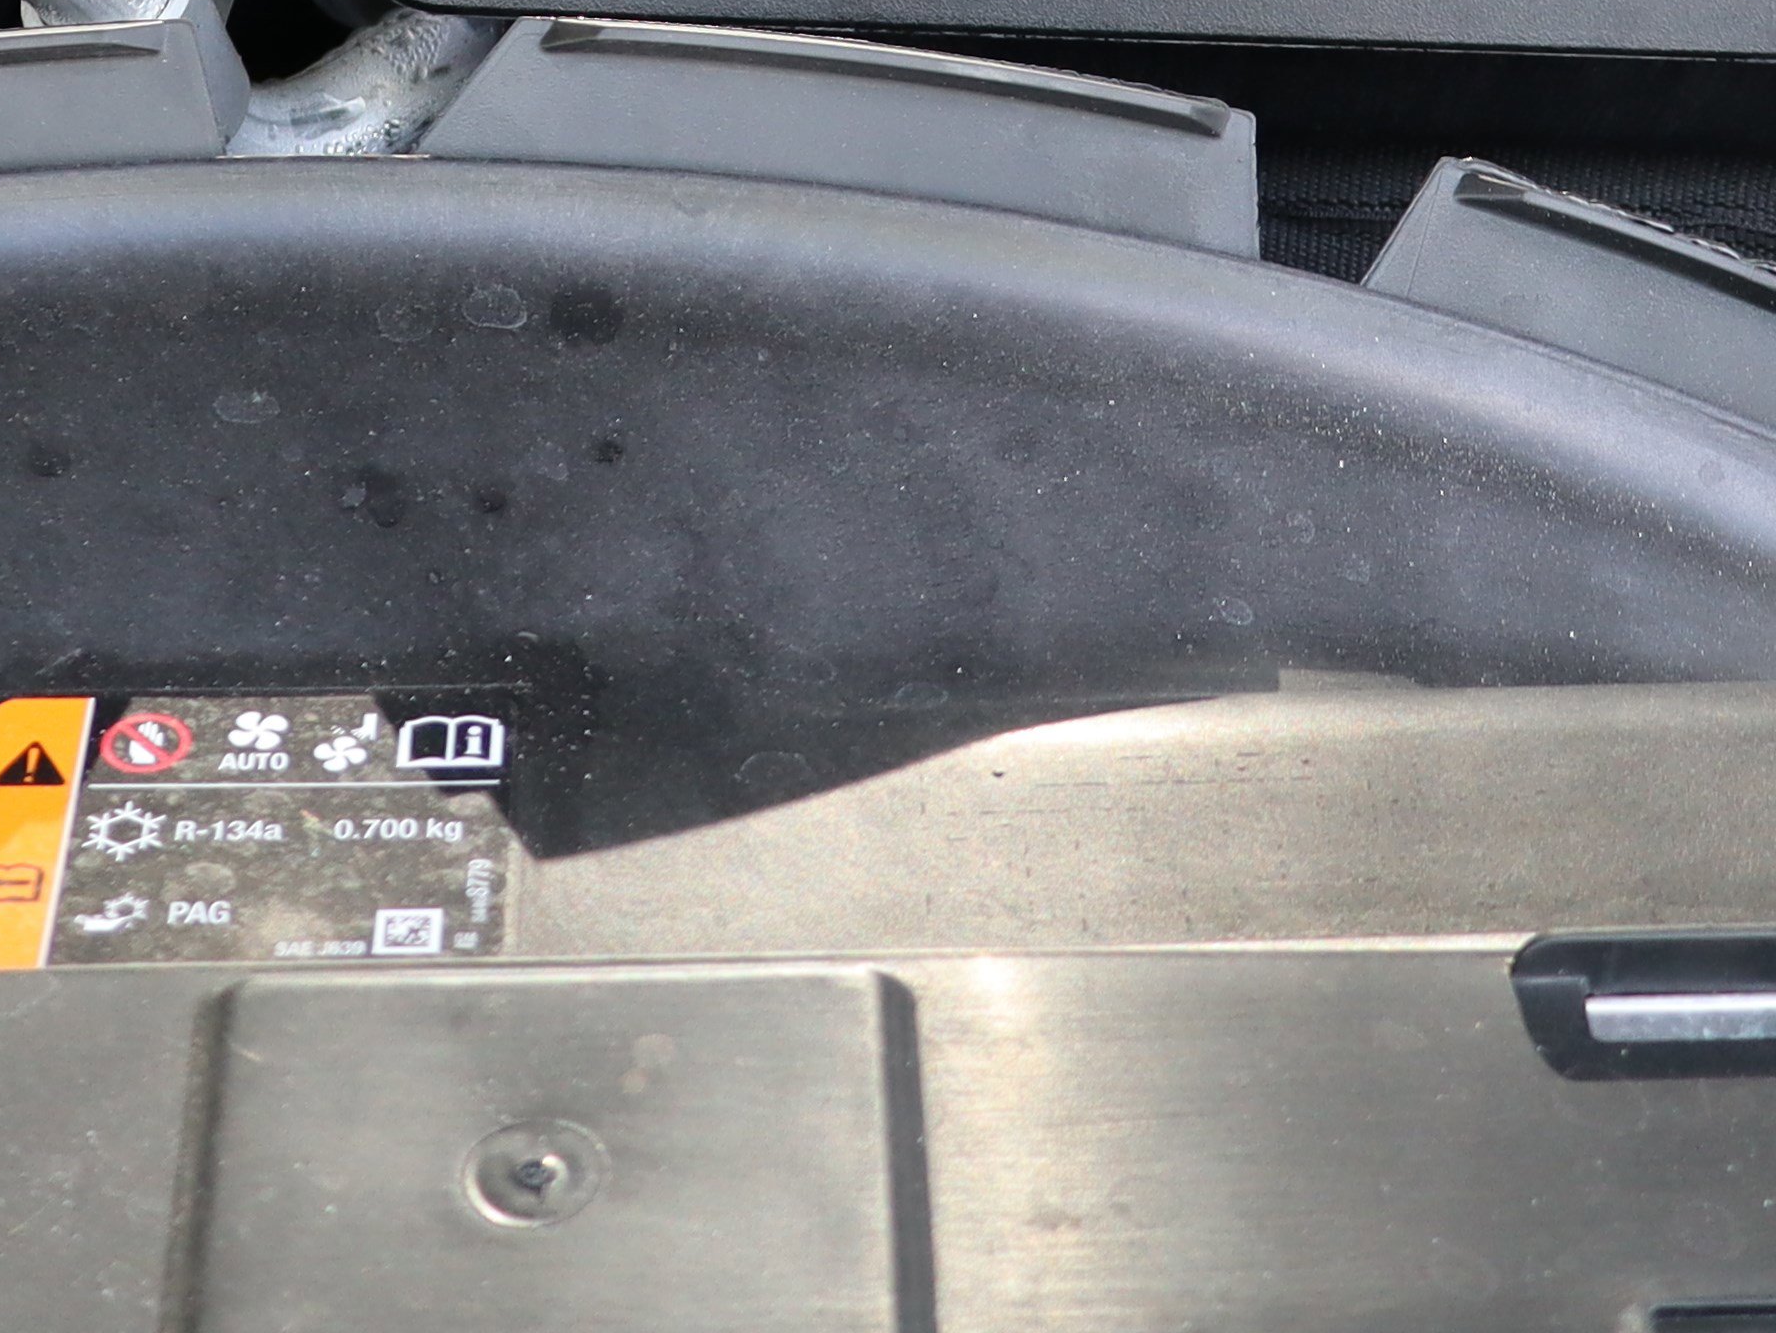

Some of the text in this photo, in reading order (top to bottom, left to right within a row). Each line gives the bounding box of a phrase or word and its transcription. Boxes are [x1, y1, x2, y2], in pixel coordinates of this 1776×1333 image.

[217, 751, 291, 771] AUTO
[174, 817, 465, 843] R-134a 0.700 kg
[167, 900, 232, 926] PAG
